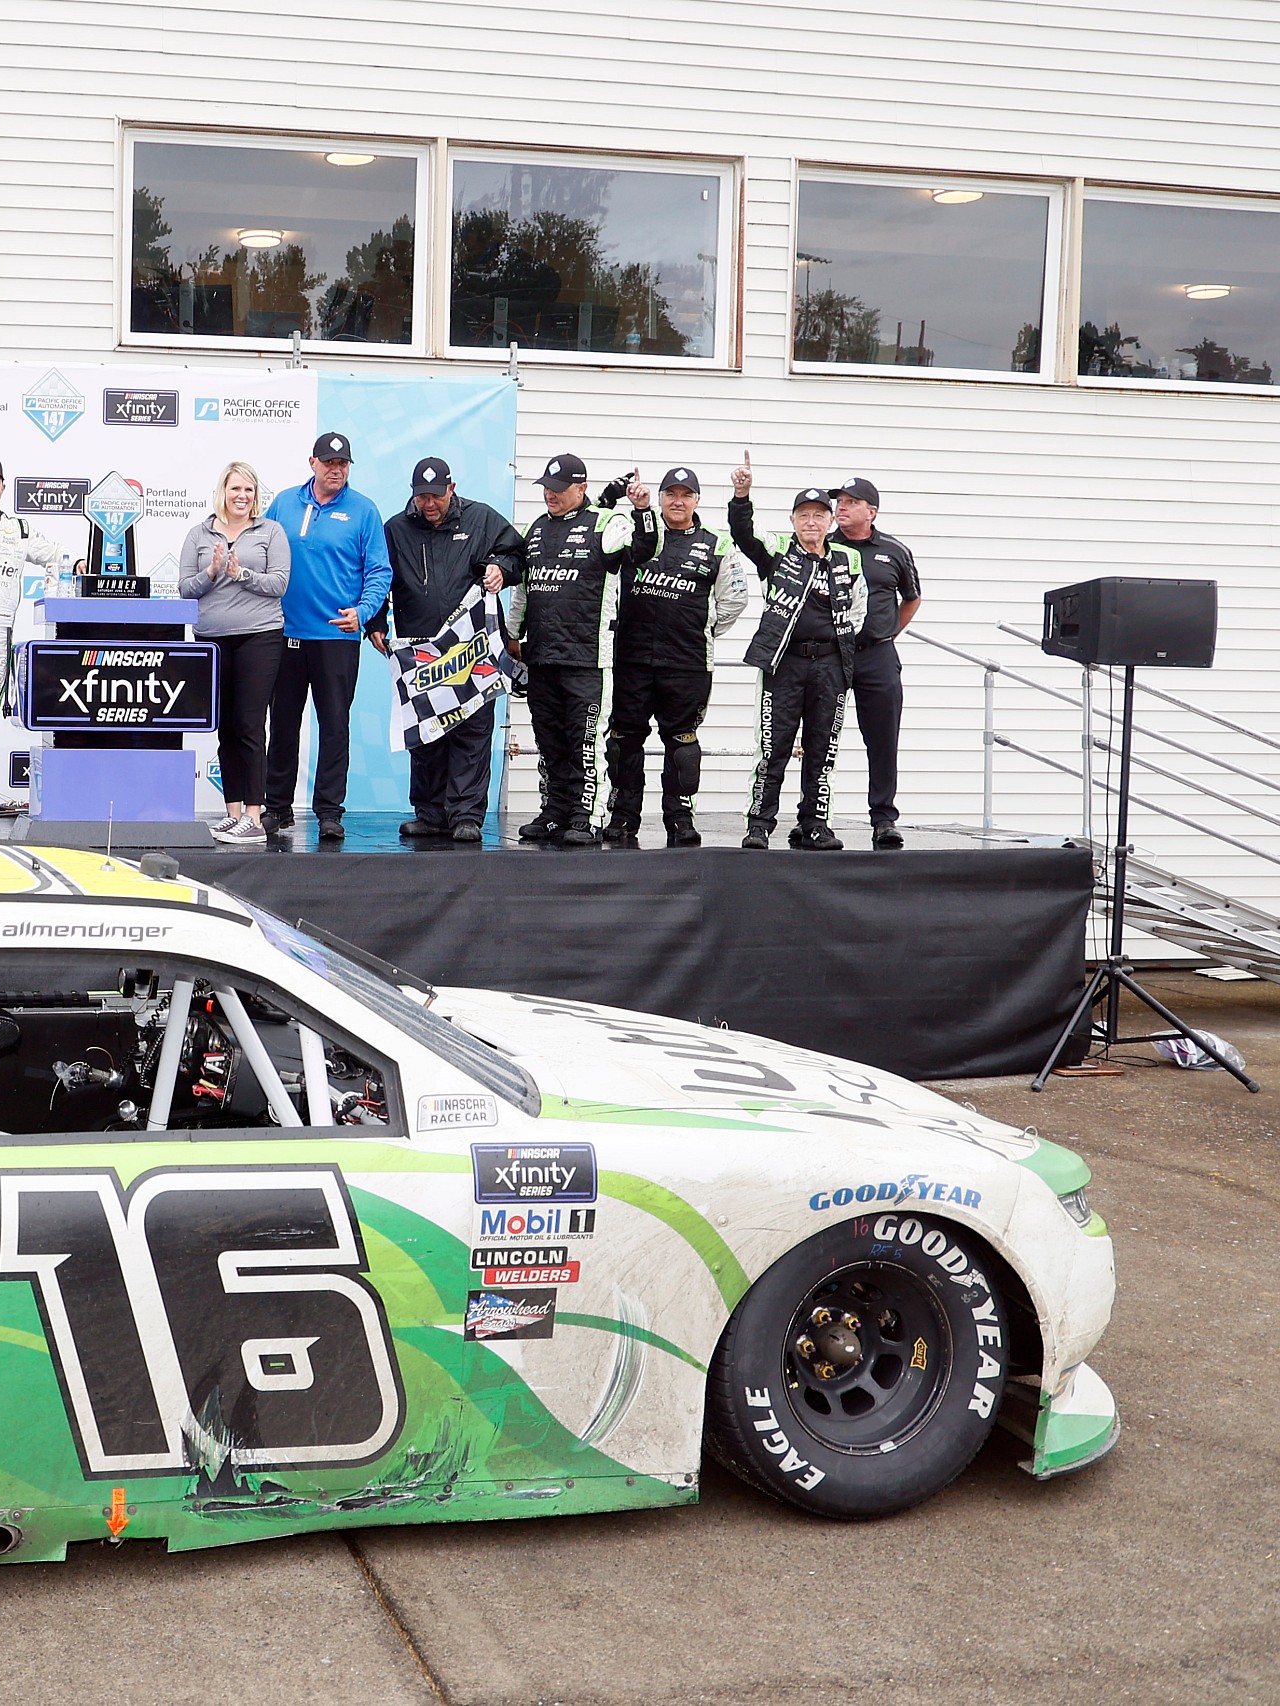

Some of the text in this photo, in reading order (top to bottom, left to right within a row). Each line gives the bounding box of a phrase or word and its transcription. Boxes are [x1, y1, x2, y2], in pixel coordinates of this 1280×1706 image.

[131, 393, 158, 401] NASCAR
[223, 398, 301, 409] PACIFIC OFFICE
[116, 400, 166, 420] xfinity
[223, 408, 292, 418] AUTOMATION
[41, 411, 65, 427] 147
[28, 490, 78, 508] xfinity
[146, 488, 187, 497] Portland
[146, 499, 207, 508] International
[104, 512, 125, 525] 147
[146, 509, 190, 519] Raceway
[97, 579, 137, 590] WINNER
[634, 568, 697, 593] Nutrien
[630, 585, 680, 600] Ag Solutions
[101, 651, 164, 667] NASCAR
[418, 636, 486, 688] SUNOCO
[58, 669, 186, 715] xfinity
[96, 708, 148, 723] SERIES
[429, 707, 470, 733] JUNE
[762, 690, 773, 759] AGRONOMIC
[582, 743, 595, 768] THE
[815, 764, 832, 820] LEADING
[825, 735, 838, 763] THE
[1, 922, 173, 942] allmendinger
[445, 1098, 487, 1110] NASCAR
[431, 1112, 488, 1124] RACE CAR
[520, 1148, 561, 1159] NASCAR
[495, 1160, 577, 1190] xfinity
[519, 1186, 553, 1197] SERIES
[480, 1209, 561, 1235] Mobil
[853, 1220, 869, 1239] 16
[475, 1250, 564, 1266] LINCOLN
[494, 1269, 571, 1283] WELDERS
[468, 1299, 552, 1318] Arrowhead
[480, 1315, 516, 1329] Brass
[745, 1386, 827, 1492] EAGLE
